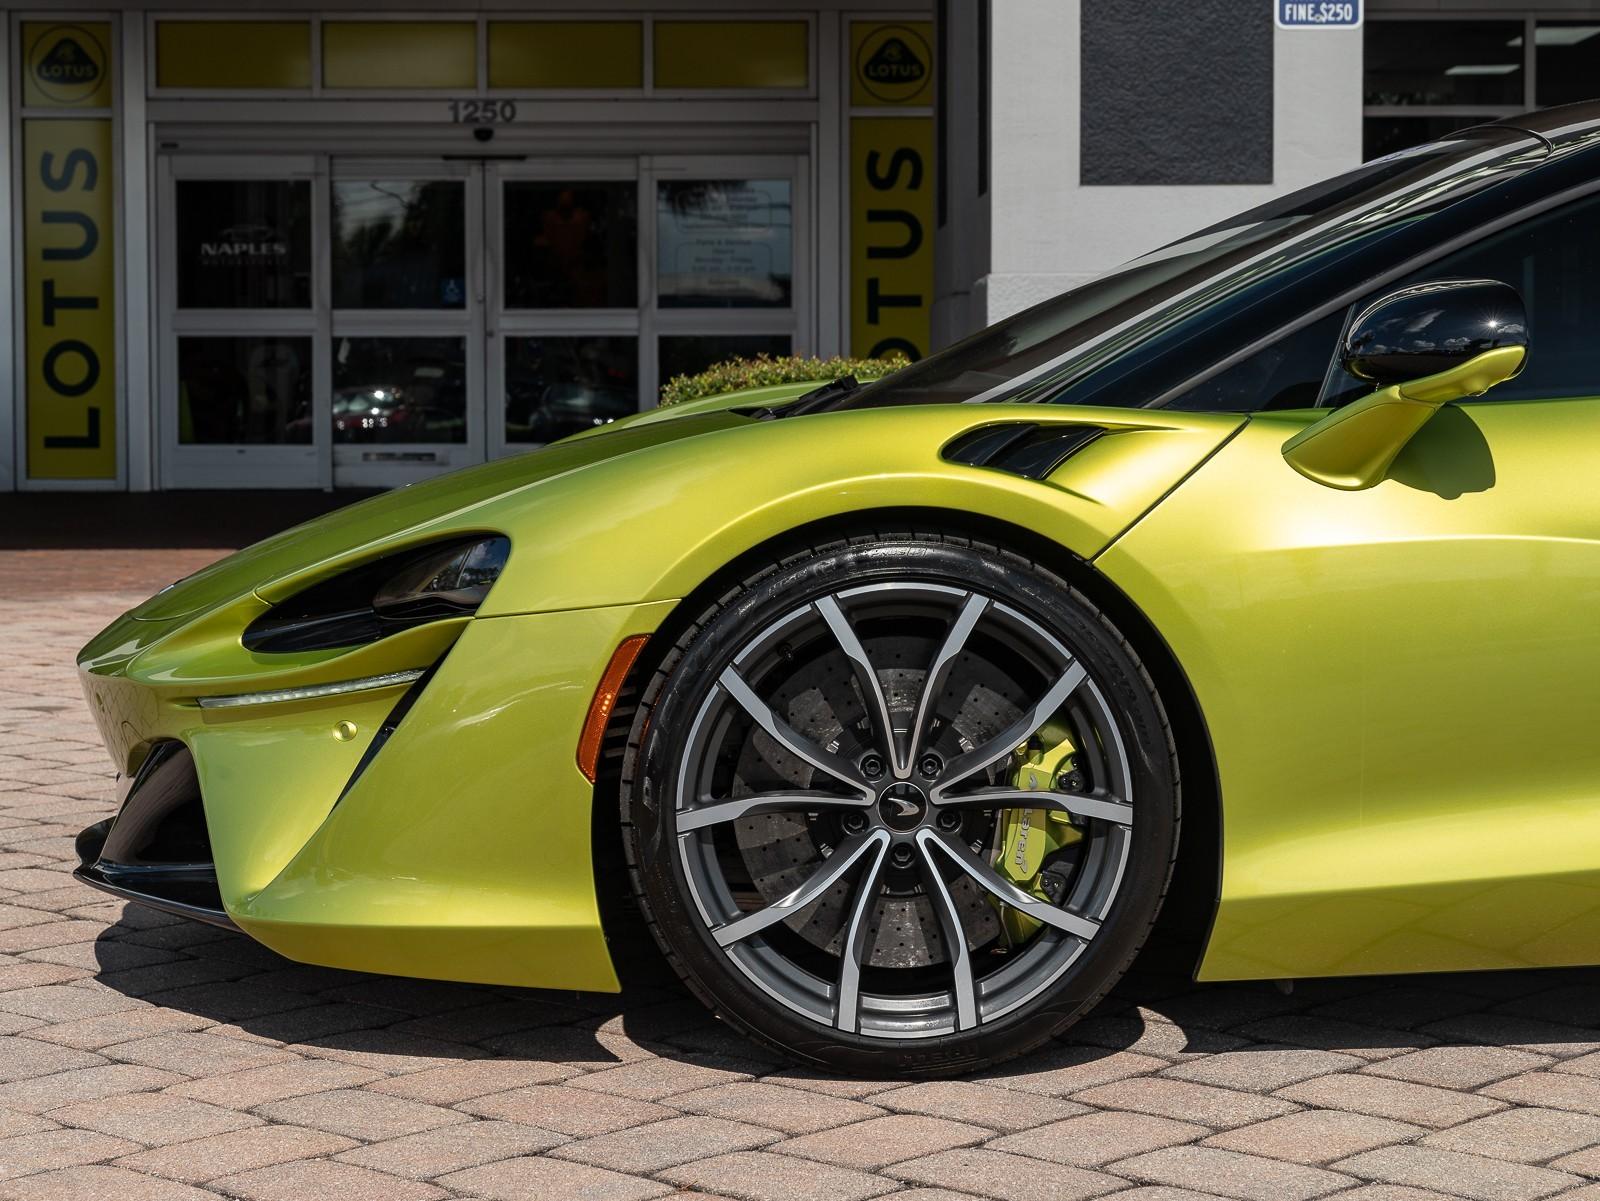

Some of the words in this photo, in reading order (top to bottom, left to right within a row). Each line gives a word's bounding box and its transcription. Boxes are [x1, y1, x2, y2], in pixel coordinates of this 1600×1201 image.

[1284, 3, 1315, 22] FINE
[1319, 2, 1353, 23] $250
[41, 64, 95, 79] LOTUS
[868, 64, 921, 78] LOTUS
[448, 99, 516, 124] 1250
[200, 242, 287, 256] NAPLES
[41, 147, 101, 449] LOTUS
